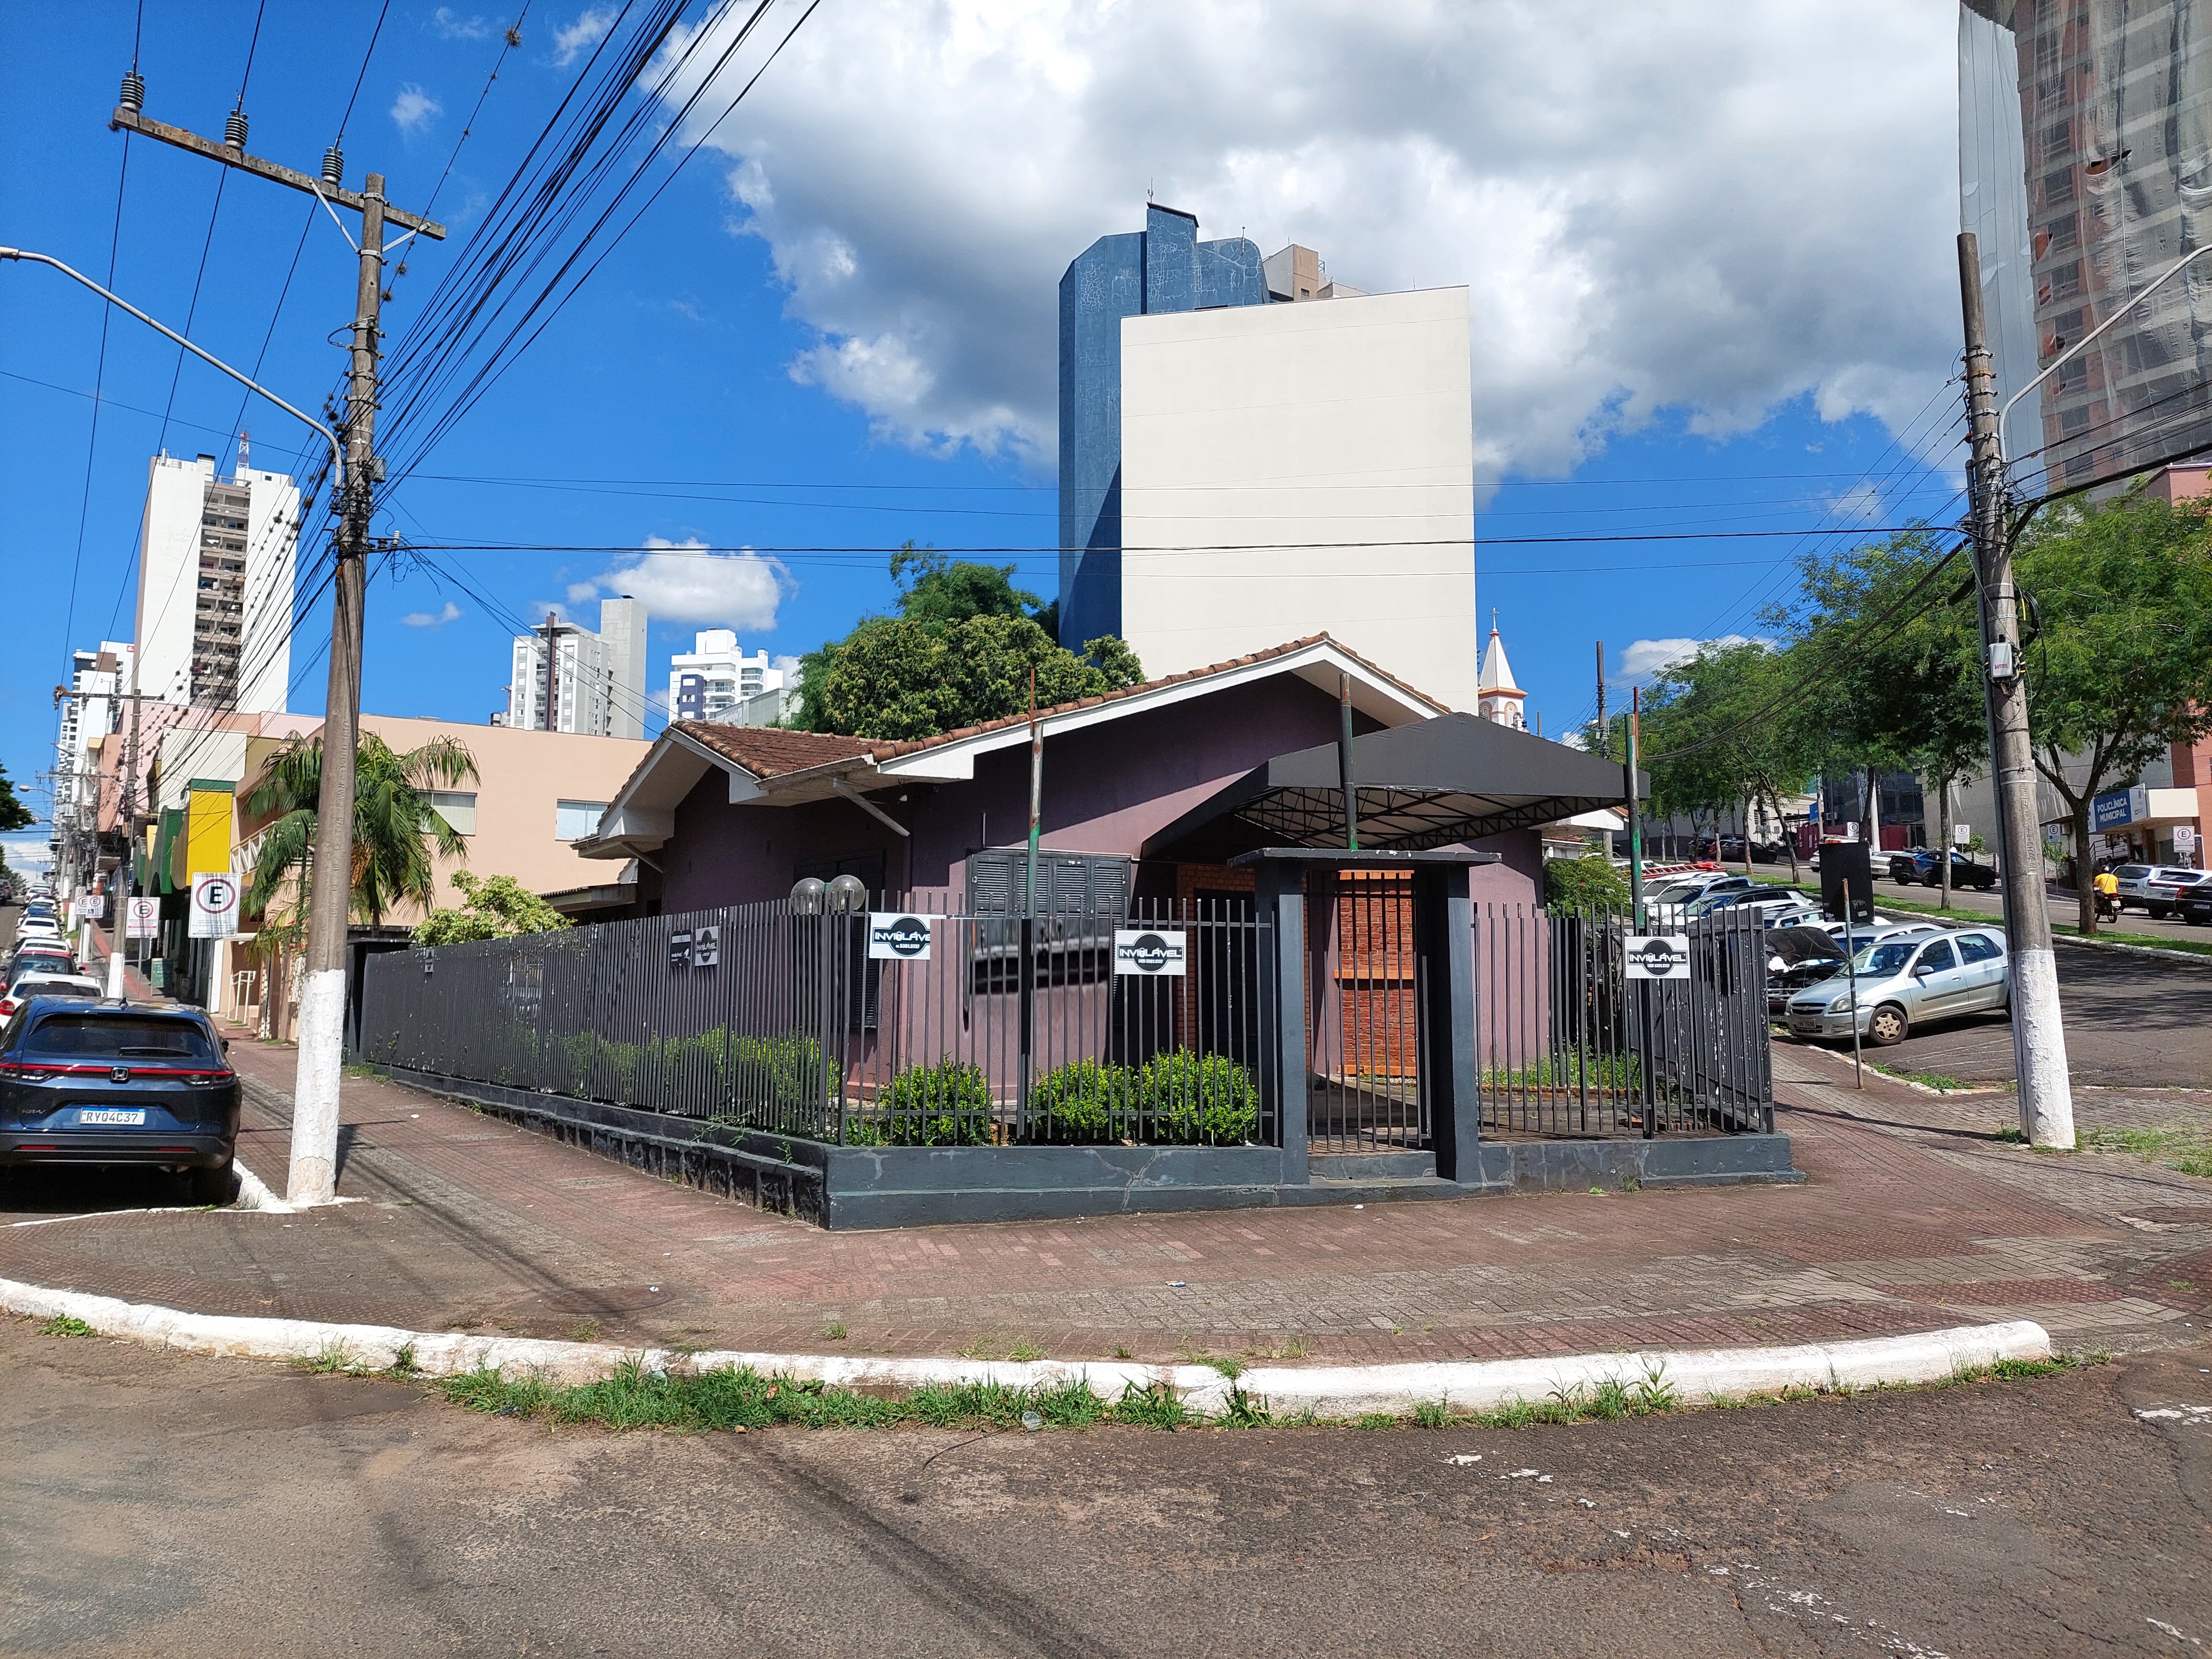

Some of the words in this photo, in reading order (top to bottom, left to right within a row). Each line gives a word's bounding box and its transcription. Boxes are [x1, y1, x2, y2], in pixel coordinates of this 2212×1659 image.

[2097, 797, 2128, 813] POLICLÍNICA
[2100, 808, 2127, 823] MUNICIPAL
[210, 886, 222, 904] E
[139, 905, 148, 915] E
[875, 931, 930, 942] INVIOLÁVE
[1119, 947, 1182, 958] INVIOLÁVEL
[1629, 952, 1686, 962] INVIOLÁVEL
[86, 1112, 138, 1123] RYQ4C37
